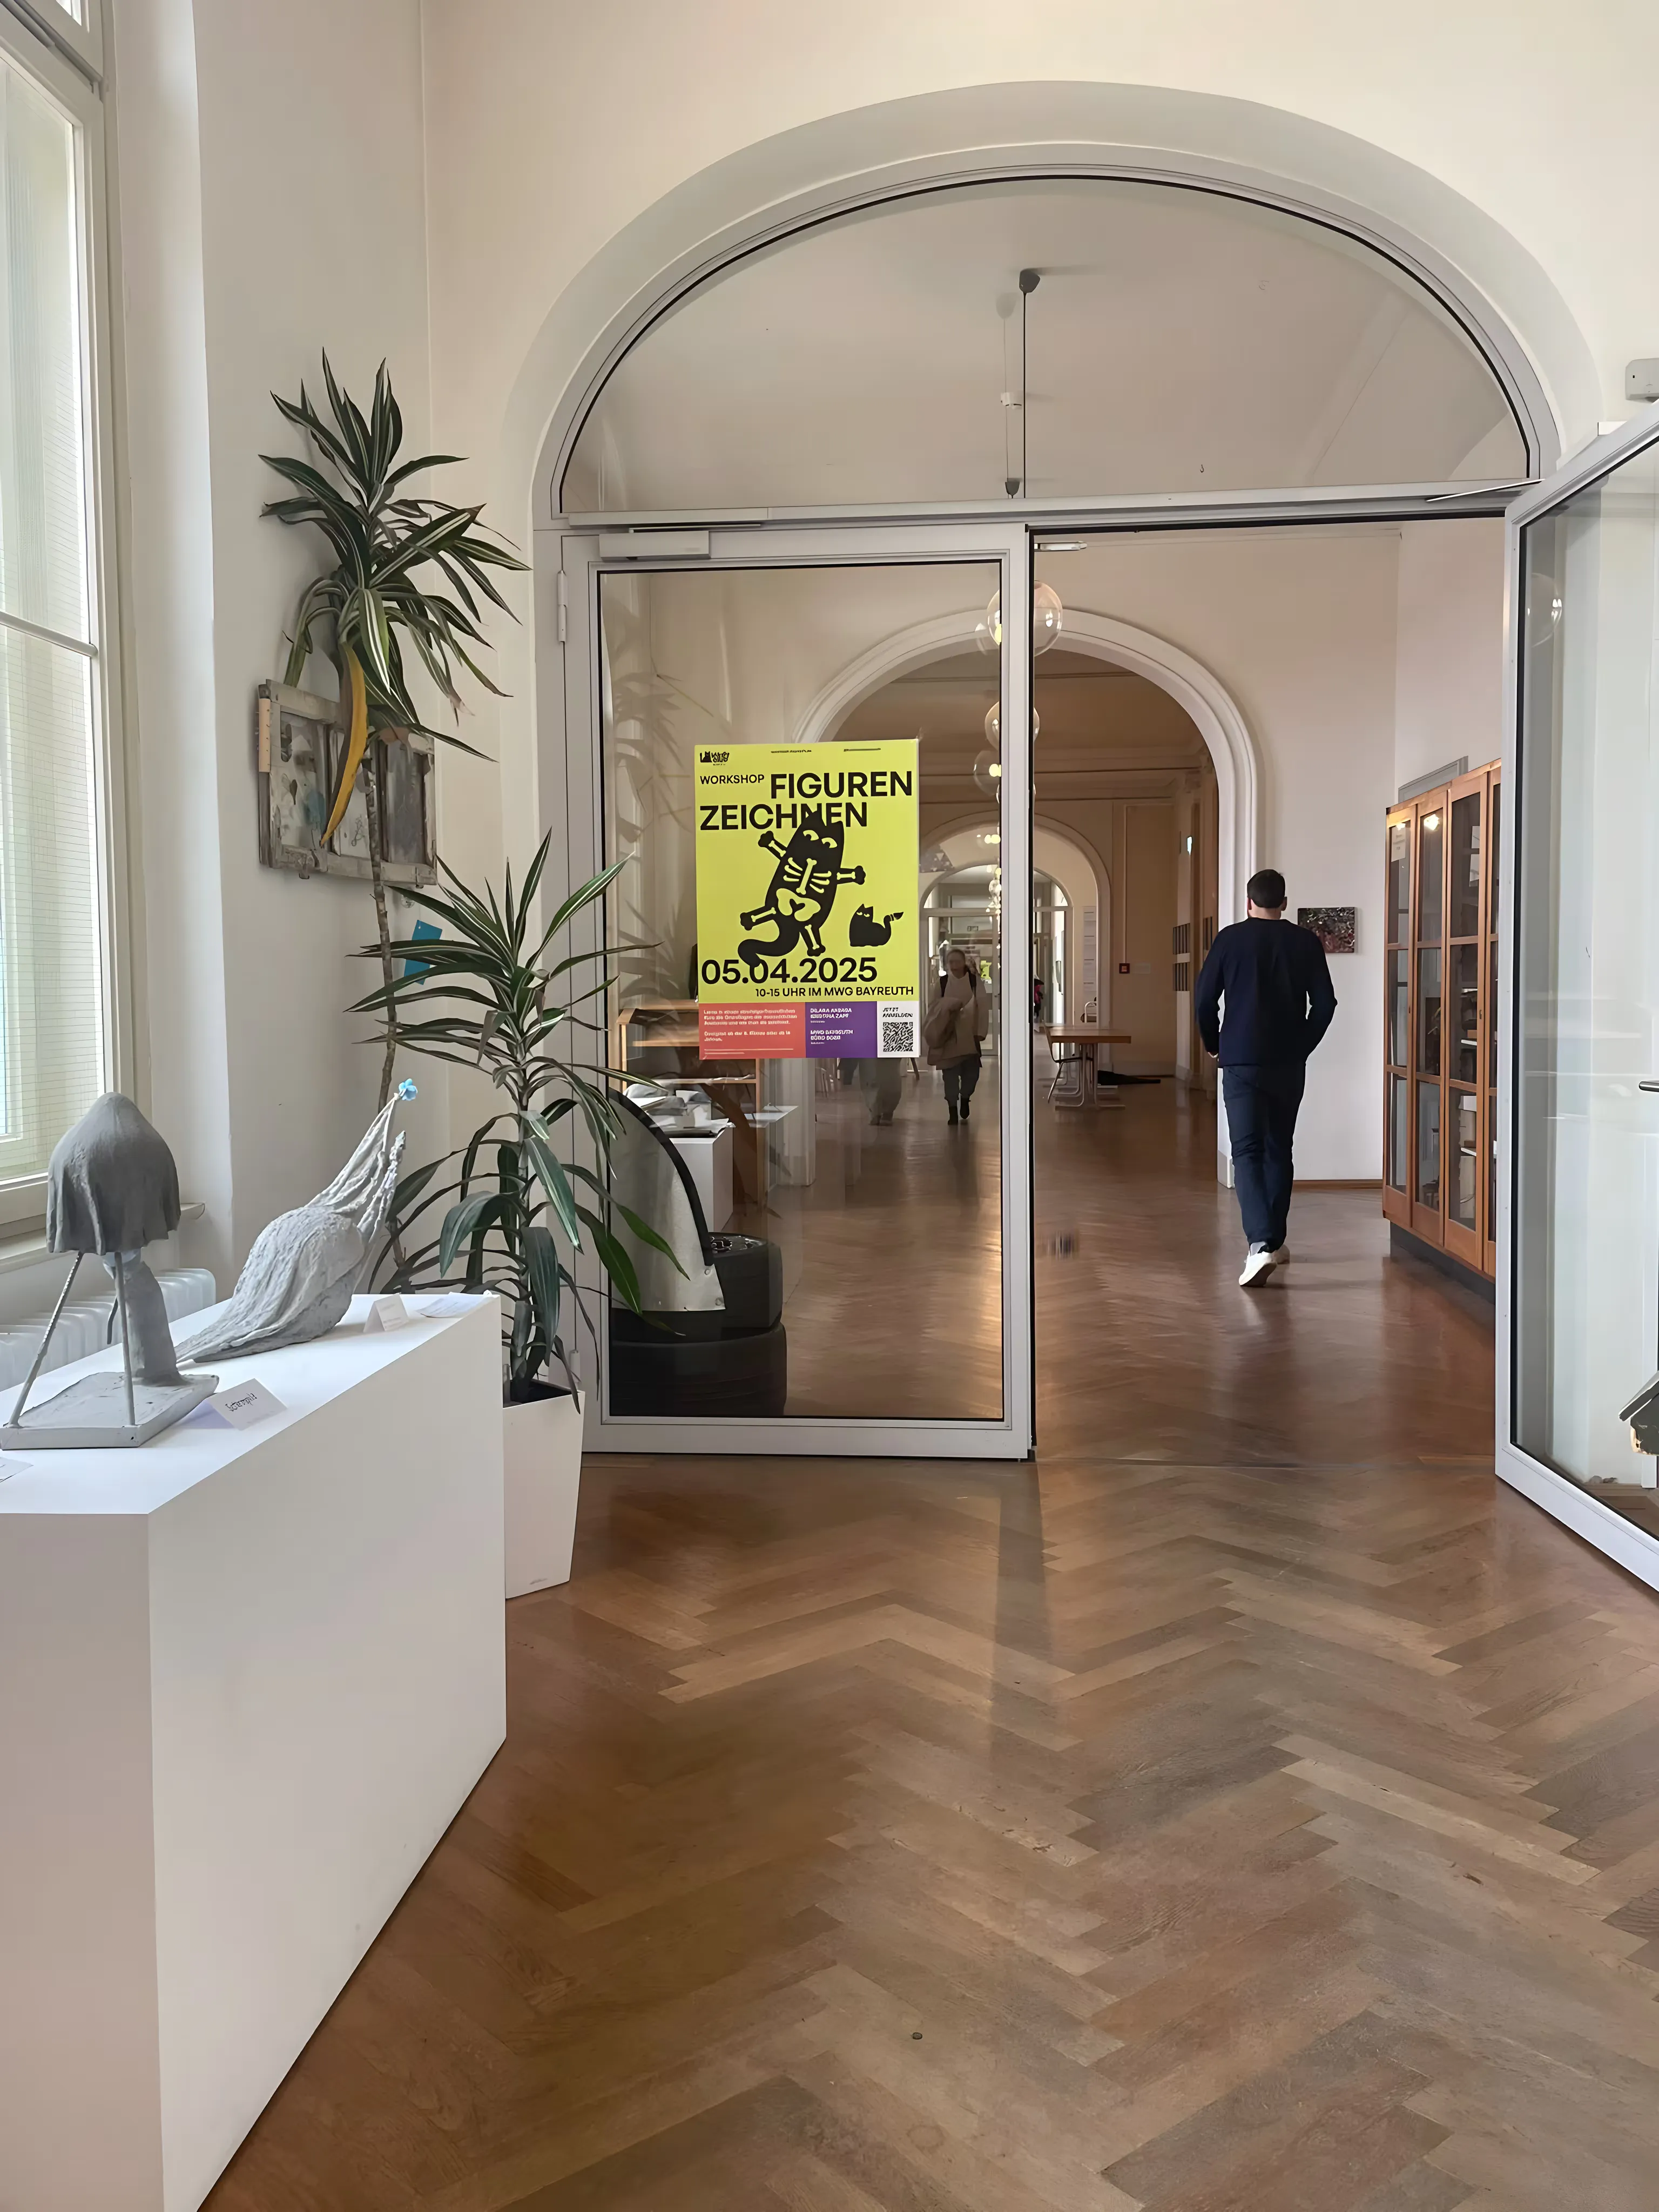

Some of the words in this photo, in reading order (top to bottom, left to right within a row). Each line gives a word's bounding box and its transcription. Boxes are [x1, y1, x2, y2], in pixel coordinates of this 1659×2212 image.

[700, 774, 765, 785] WORKSHOP
[771, 771, 912, 799] FIGUREN
[702, 957, 878, 984] 05.04.2025
[756, 988, 780, 997] 10-15
[783, 987, 806, 996] UHR
[808, 987, 821, 996] IM
[824, 987, 853, 996] MWG
[856, 986, 914, 996] BAYREUTH
